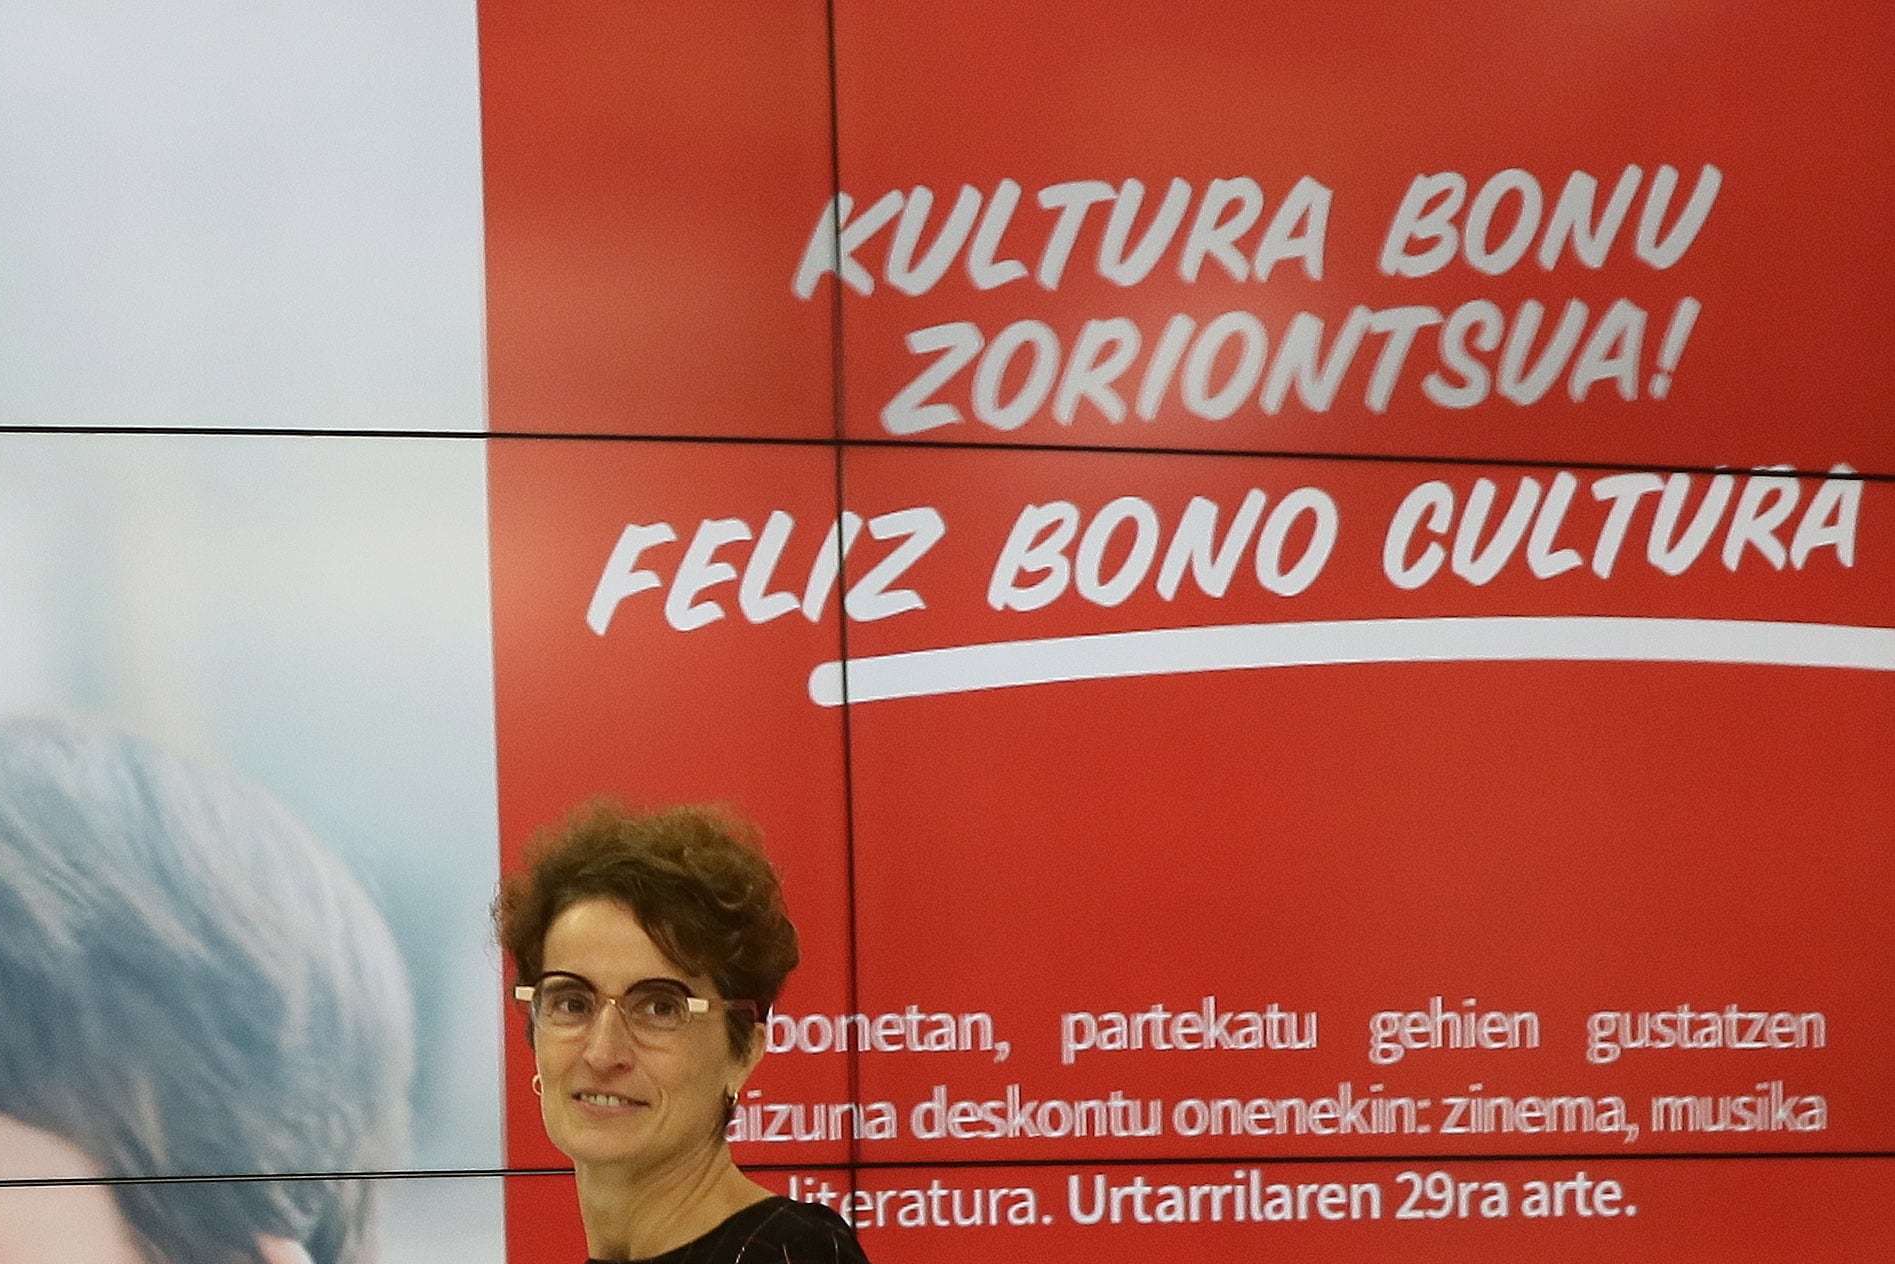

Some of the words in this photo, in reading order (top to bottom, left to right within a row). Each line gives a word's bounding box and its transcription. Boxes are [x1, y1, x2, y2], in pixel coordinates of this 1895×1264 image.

[790, 174, 1335, 301] KULTURA
[1376, 162, 1724, 280] BONU
[878, 295, 1703, 437] ZORIONTSUA!
[582, 505, 949, 639] FELIZ
[984, 485, 1341, 614] BONO
[1381, 461, 1865, 592] CULTURA
[763, 1003, 1012, 1063] bonetan,
[1060, 994, 1319, 1066] partekatu
[1367, 994, 1541, 1066] gehien
[1585, 1002, 1827, 1065] gustatzen
[909, 1082, 1164, 1141] deskontu
[1171, 1080, 1433, 1138] onenekin:
[1438, 1081, 1641, 1144] zinema,
[1650, 1079, 1828, 1134] musika
[1067, 1167, 1383, 1226] Urtarrilaren
[1393, 1169, 1511, 1221] 29ra
[1519, 1170, 1638, 1220] arte.
